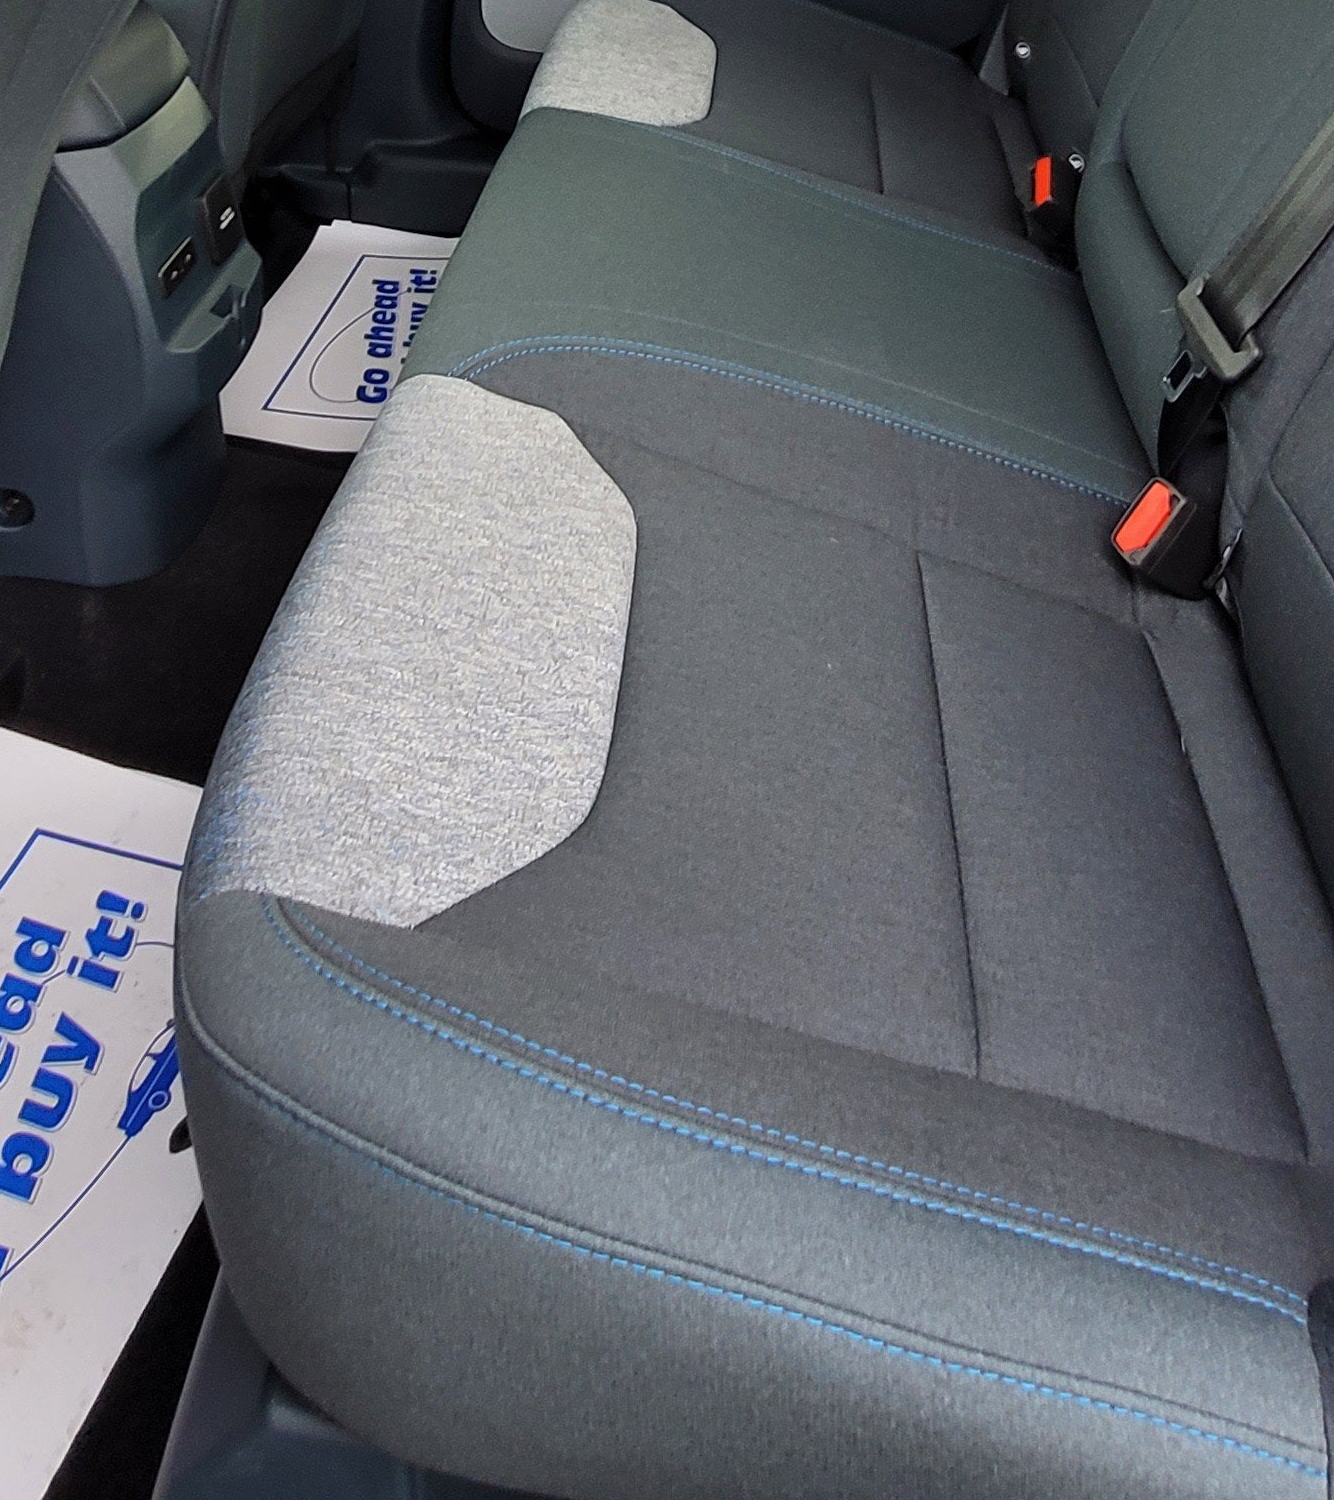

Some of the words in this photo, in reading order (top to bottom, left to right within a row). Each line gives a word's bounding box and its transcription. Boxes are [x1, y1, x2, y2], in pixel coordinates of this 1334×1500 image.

[363, 279, 400, 358] ahead
[356, 368, 388, 403] Go
[67, 889, 147, 991] it!
